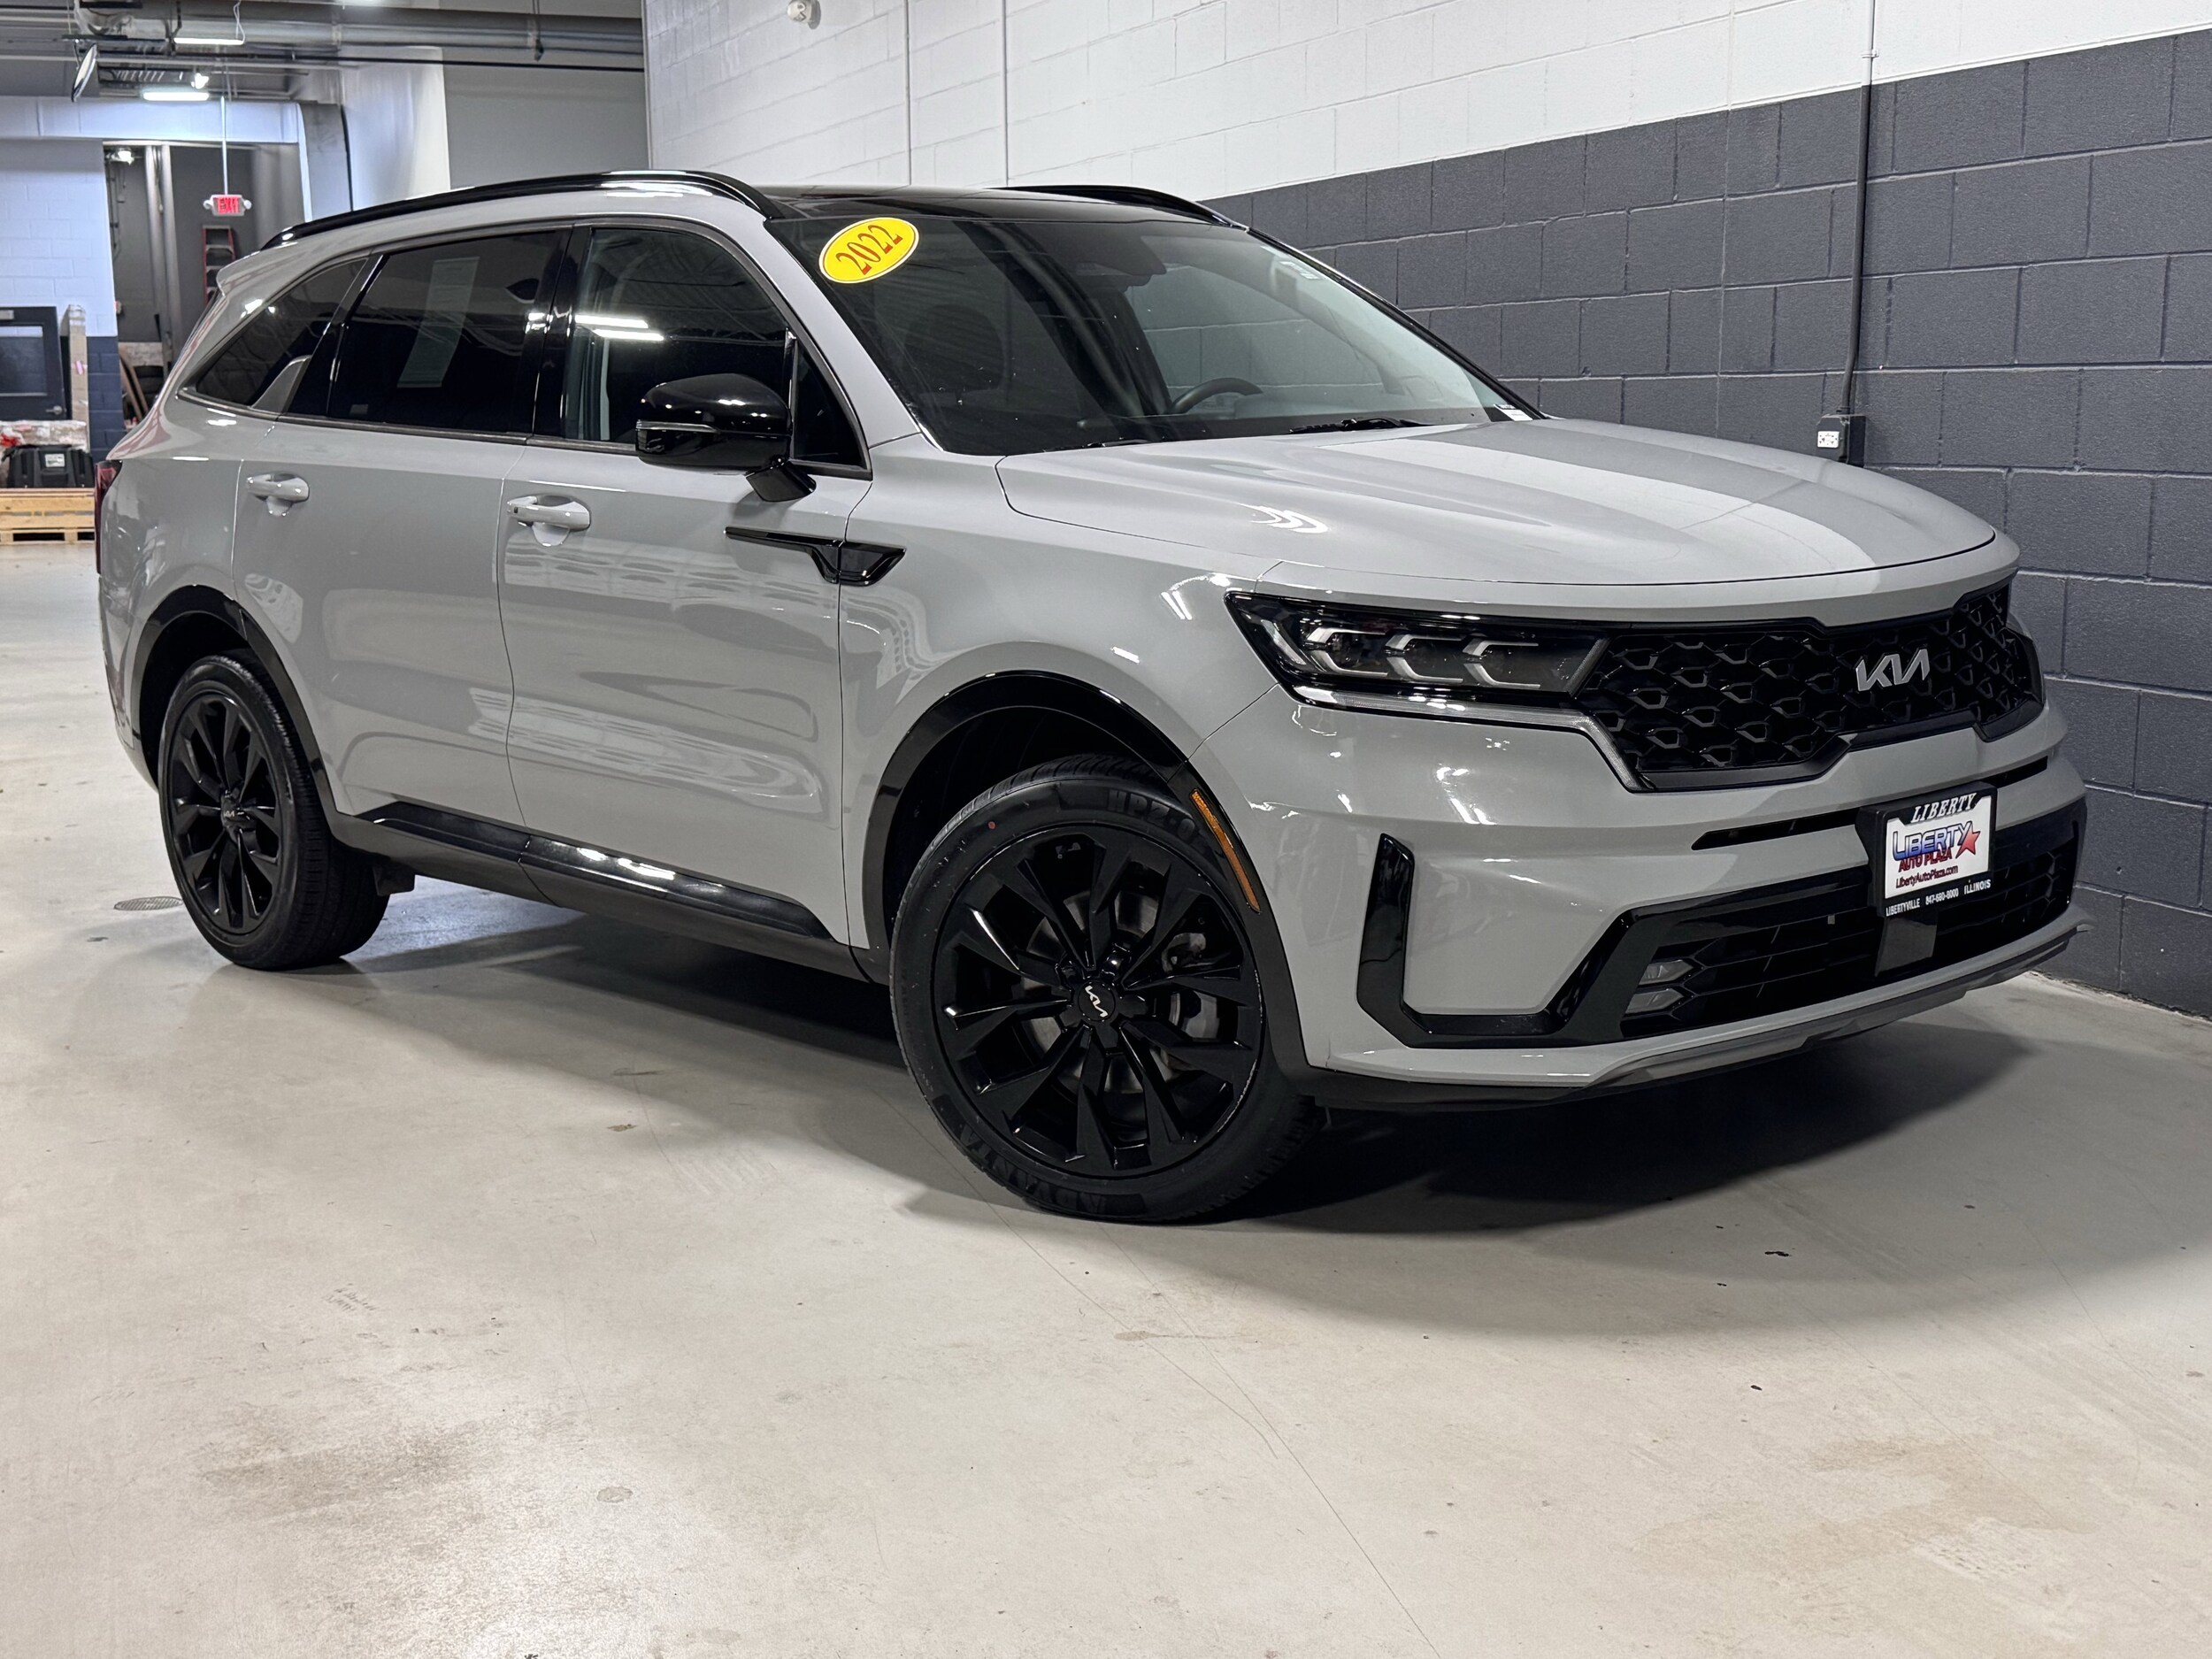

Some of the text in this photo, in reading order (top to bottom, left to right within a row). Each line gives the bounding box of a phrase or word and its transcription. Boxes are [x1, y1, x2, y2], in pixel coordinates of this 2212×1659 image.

[218, 197, 240, 213] EXIT
[835, 225, 903, 275] 2022
[1855, 648, 1931, 692] KIA
[1910, 793, 1977, 824] LIBERTY
[1893, 821, 1972, 861] LIBERTY
[1895, 864, 1959, 889] LibertyAutoPlaza.com
[1898, 848, 1952, 872] AUTO PLAZA
[1886, 897, 1921, 917] LIBERTYVILLE
[1963, 879, 1991, 895] ILLINOIS
